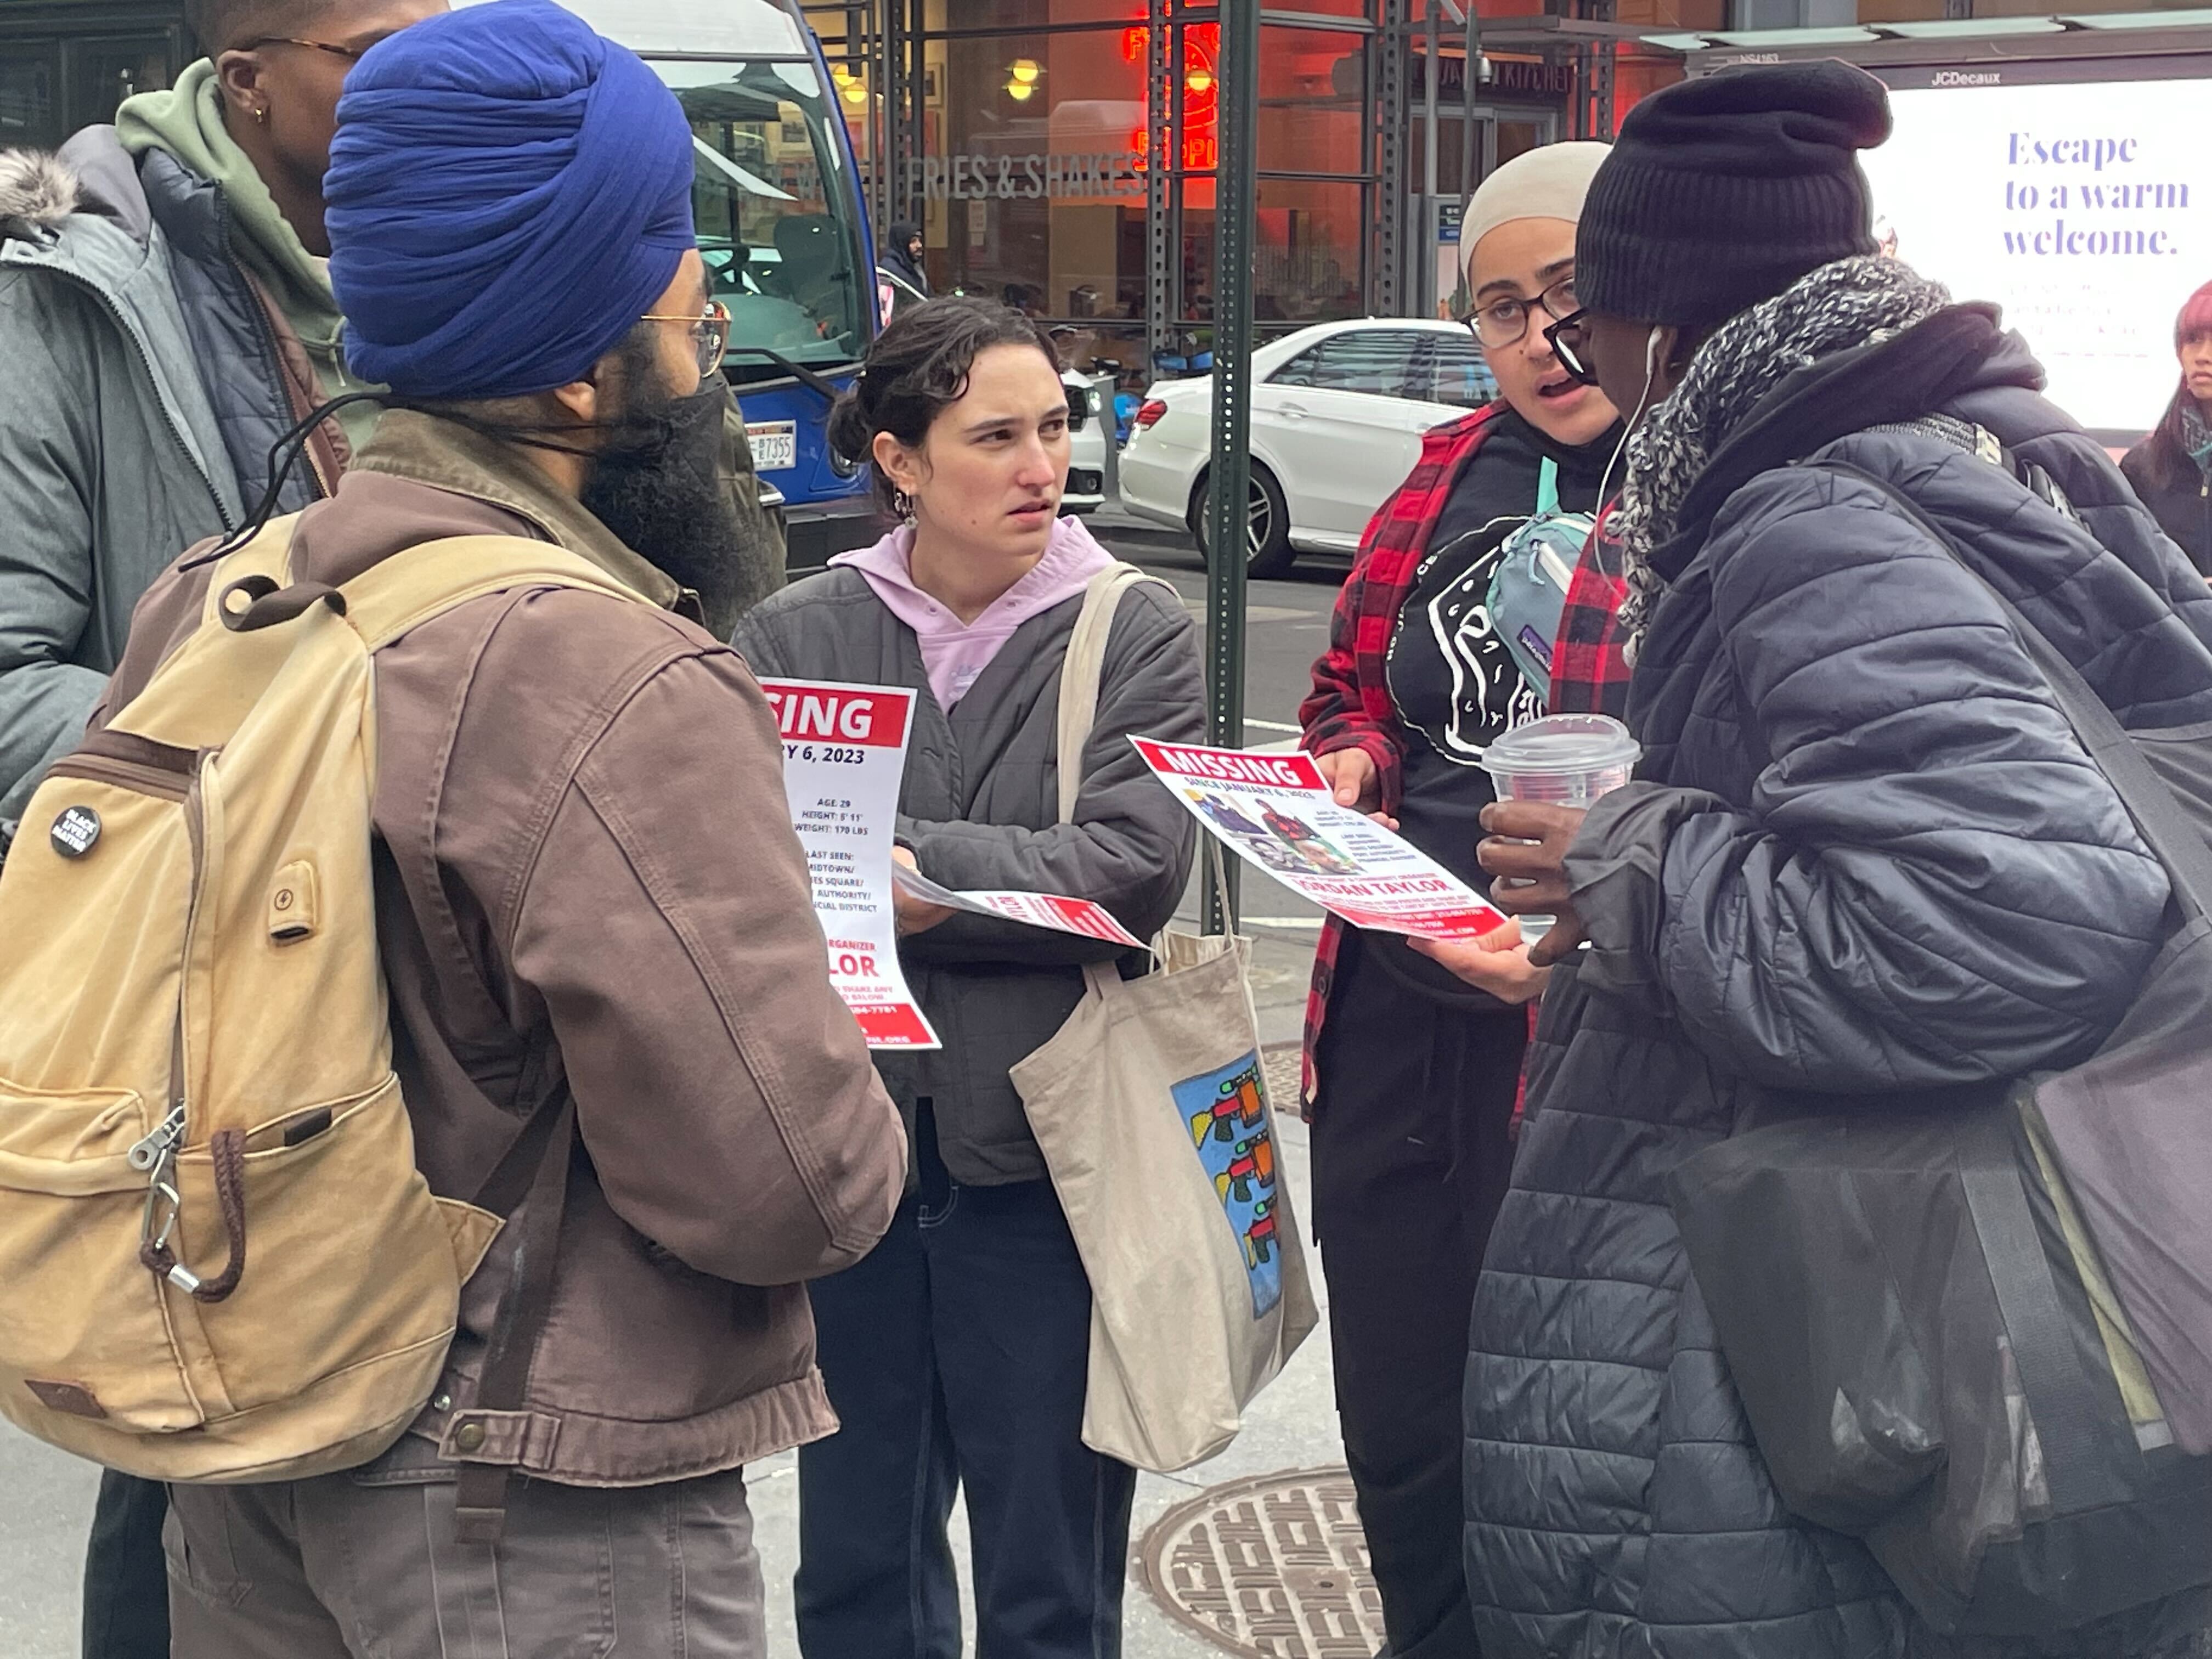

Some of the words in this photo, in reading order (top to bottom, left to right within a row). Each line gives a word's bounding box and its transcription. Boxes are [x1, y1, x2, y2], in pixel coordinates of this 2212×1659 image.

[1931, 71, 2001, 86] JCDecaux
[2008, 132, 2137, 171] Escape
[996, 155, 1016, 200] &
[1024, 153, 1145, 199] SHAKES
[2006, 180, 2039, 211] to
[2049, 185, 2068, 210] a
[2080, 183, 2189, 210] warm
[2003, 219, 2178, 255] welcome.
[803, 746, 817, 763] 6,
[822, 747, 865, 764] 2023
[1158, 747, 1305, 787] MISSING
